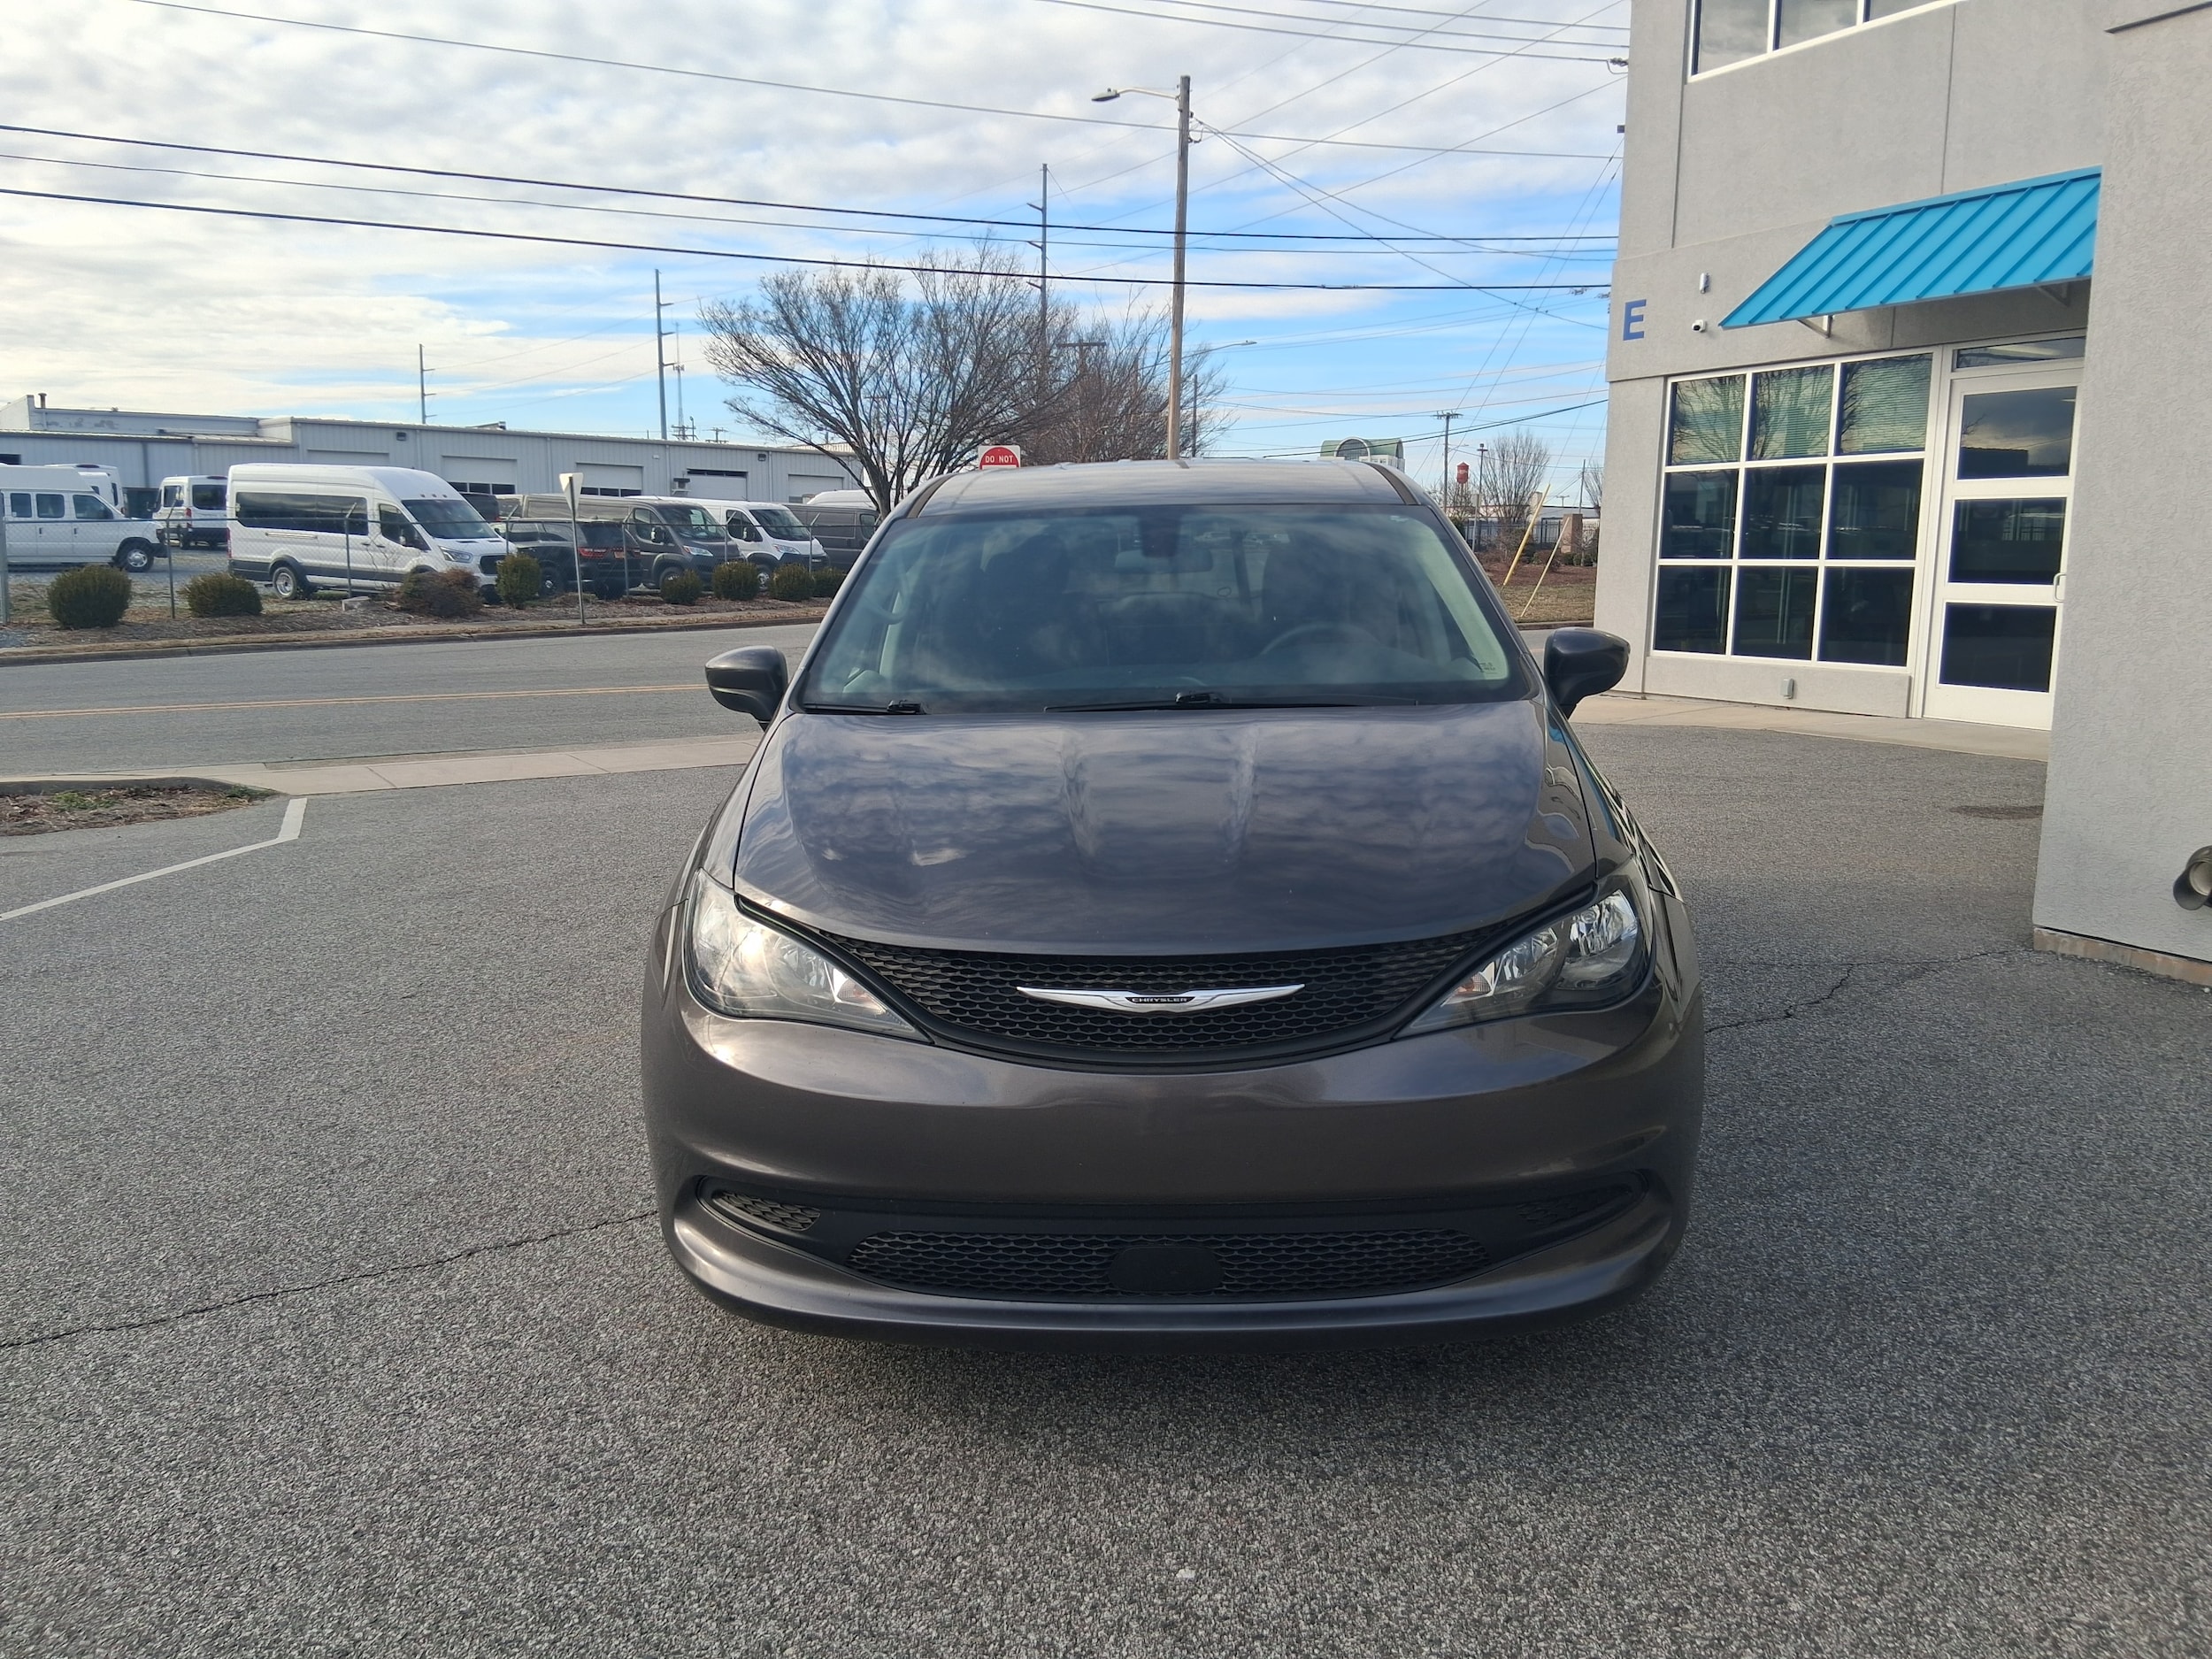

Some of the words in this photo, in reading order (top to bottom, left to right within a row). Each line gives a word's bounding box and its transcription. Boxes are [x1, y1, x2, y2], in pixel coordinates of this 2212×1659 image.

[1623, 299, 1647, 341] E
[985, 455, 995, 464] DO
[998, 455, 1014, 464] NOT
